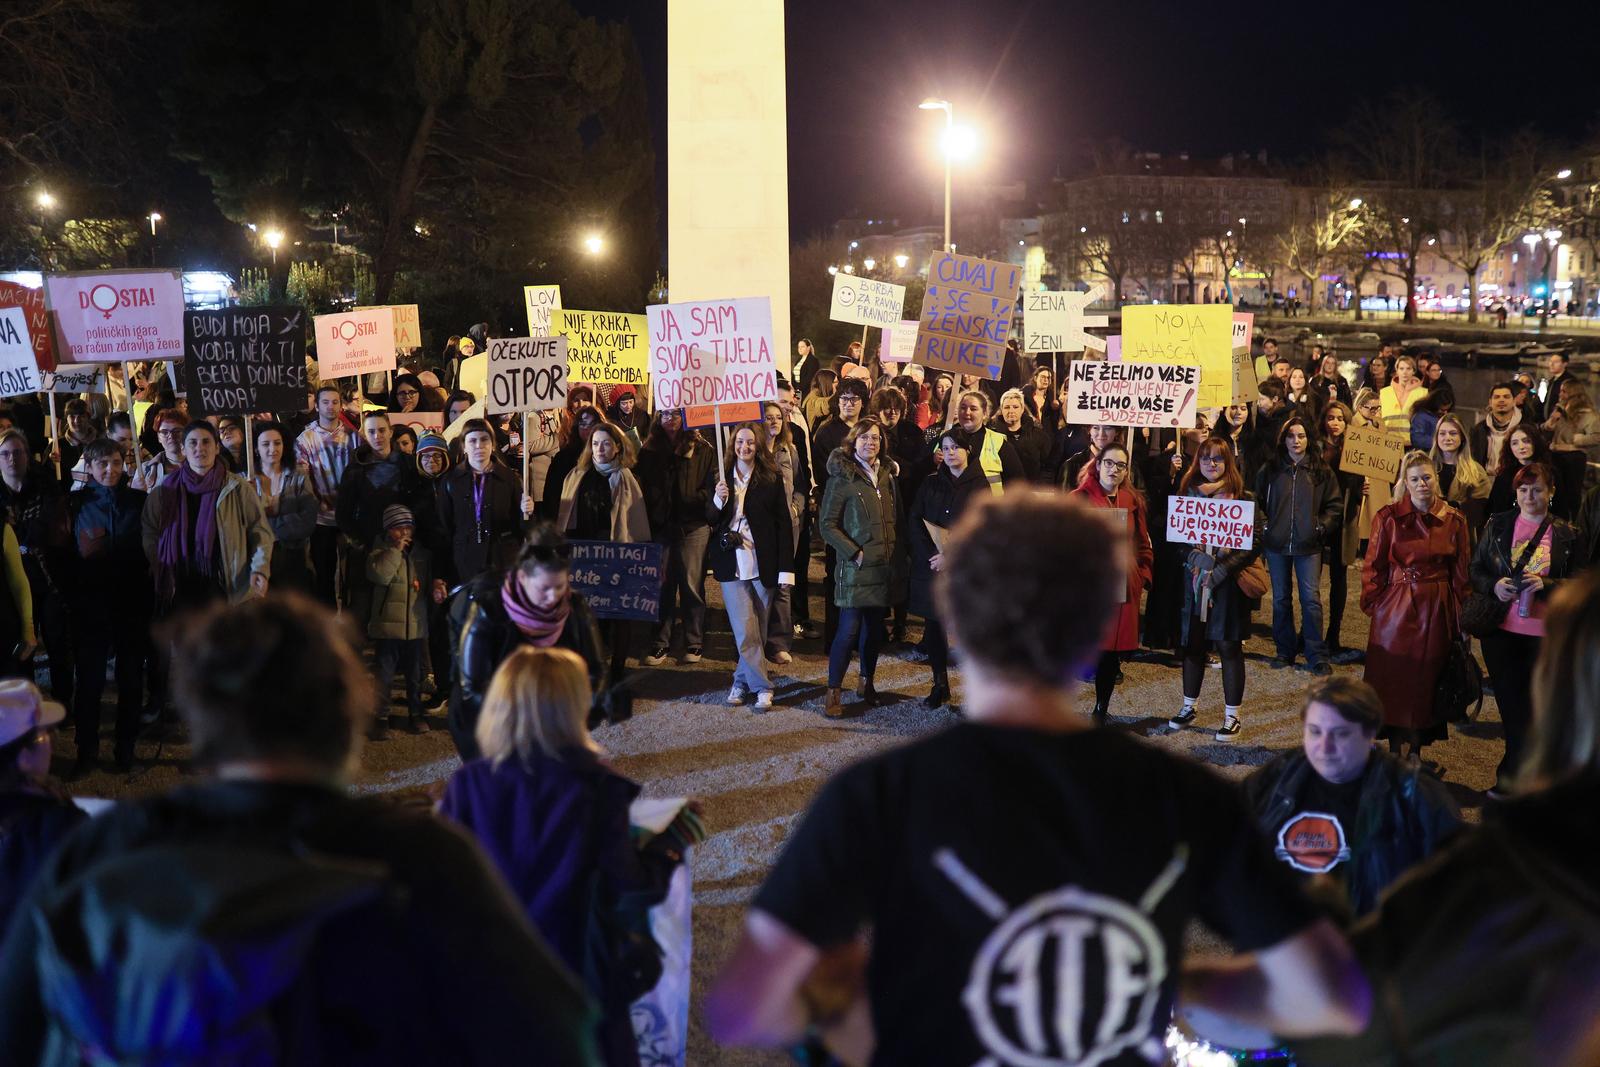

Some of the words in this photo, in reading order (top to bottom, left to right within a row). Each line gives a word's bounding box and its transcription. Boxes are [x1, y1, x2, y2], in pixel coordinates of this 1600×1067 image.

[529, 290, 556, 307] LOV
[857, 294, 870, 304] ZA
[860, 280, 894, 298] BORBA
[79, 284, 156, 320] DOSTA!
[944, 289, 971, 312] SE
[1029, 292, 1066, 311] ŽENA
[86, 325, 130, 341] političkih
[133, 326, 158, 340] igara
[192, 315, 226, 338] BUDI
[332, 320, 377, 346] DOSTA!
[564, 313, 586, 334] NIJE
[592, 314, 632, 332] KRHKA
[656, 309, 682, 342] JA
[691, 306, 737, 336] SAM
[927, 306, 1009, 342] ŽENSKE
[1155, 311, 1207, 342] MOJA
[71, 344, 82, 354] na
[86, 341, 113, 353] račun
[116, 340, 154, 354] zdravlja
[158, 338, 181, 350] žena
[242, 342, 271, 362] NEK
[278, 341, 294, 363] TI
[491, 340, 557, 362] OČEKUJTE
[581, 332, 603, 348] KAO
[604, 334, 638, 351] CVIJET
[926, 337, 989, 367] RUKE
[1029, 332, 1062, 350] ŽENI
[567, 348, 603, 365] KRHKA
[605, 351, 617, 367] JE
[656, 343, 701, 374] SVOG
[709, 336, 770, 365] TIJELA
[0, 367, 35, 395] GDJE
[197, 364, 240, 384] BEBU
[247, 364, 305, 388] DONESE
[581, 367, 601, 380] KAO
[605, 366, 643, 383] BOMBA
[1074, 363, 1097, 381] NE
[1099, 361, 1154, 381] ŽELIMO
[1158, 365, 1196, 384] VAŠE
[492, 364, 565, 407] OTPOR
[658, 372, 775, 408] GOSPODARICA
[1091, 380, 1184, 397] KOMPLIMENTE
[201, 388, 257, 411] RODA!
[1077, 391, 1130, 410] ŽELIMO
[1138, 394, 1174, 412] VAŠE
[1098, 406, 1162, 424] BUDŽETE
[1349, 432, 1361, 441] ZA
[1367, 435, 1381, 445] SVE
[1345, 450, 1365, 466] VIŠE
[1175, 497, 1242, 519] ŽENSKO
[1200, 532, 1243, 548] STVAR
